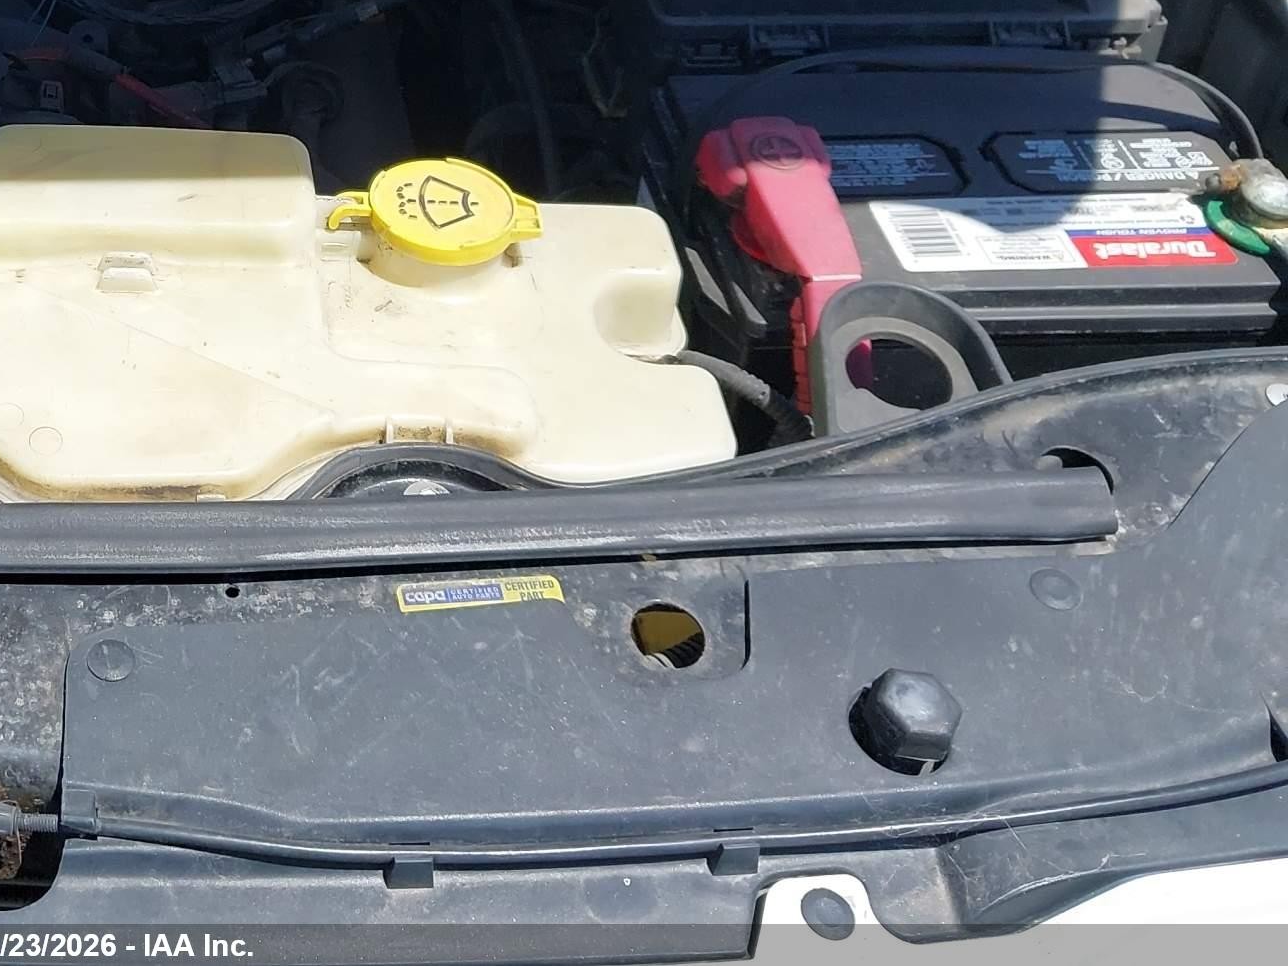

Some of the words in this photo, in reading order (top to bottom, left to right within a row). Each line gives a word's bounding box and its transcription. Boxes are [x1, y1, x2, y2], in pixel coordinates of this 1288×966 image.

[1096, 228, 1135, 236] TOUGH
[1139, 228, 1188, 236] PROVEN
[1092, 240, 1217, 260] Duralast
[450, 587, 500, 596] CERTIFIED
[504, 579, 555, 592] CERTIFIED
[404, 589, 446, 604] capa
[520, 590, 545, 602] PART
